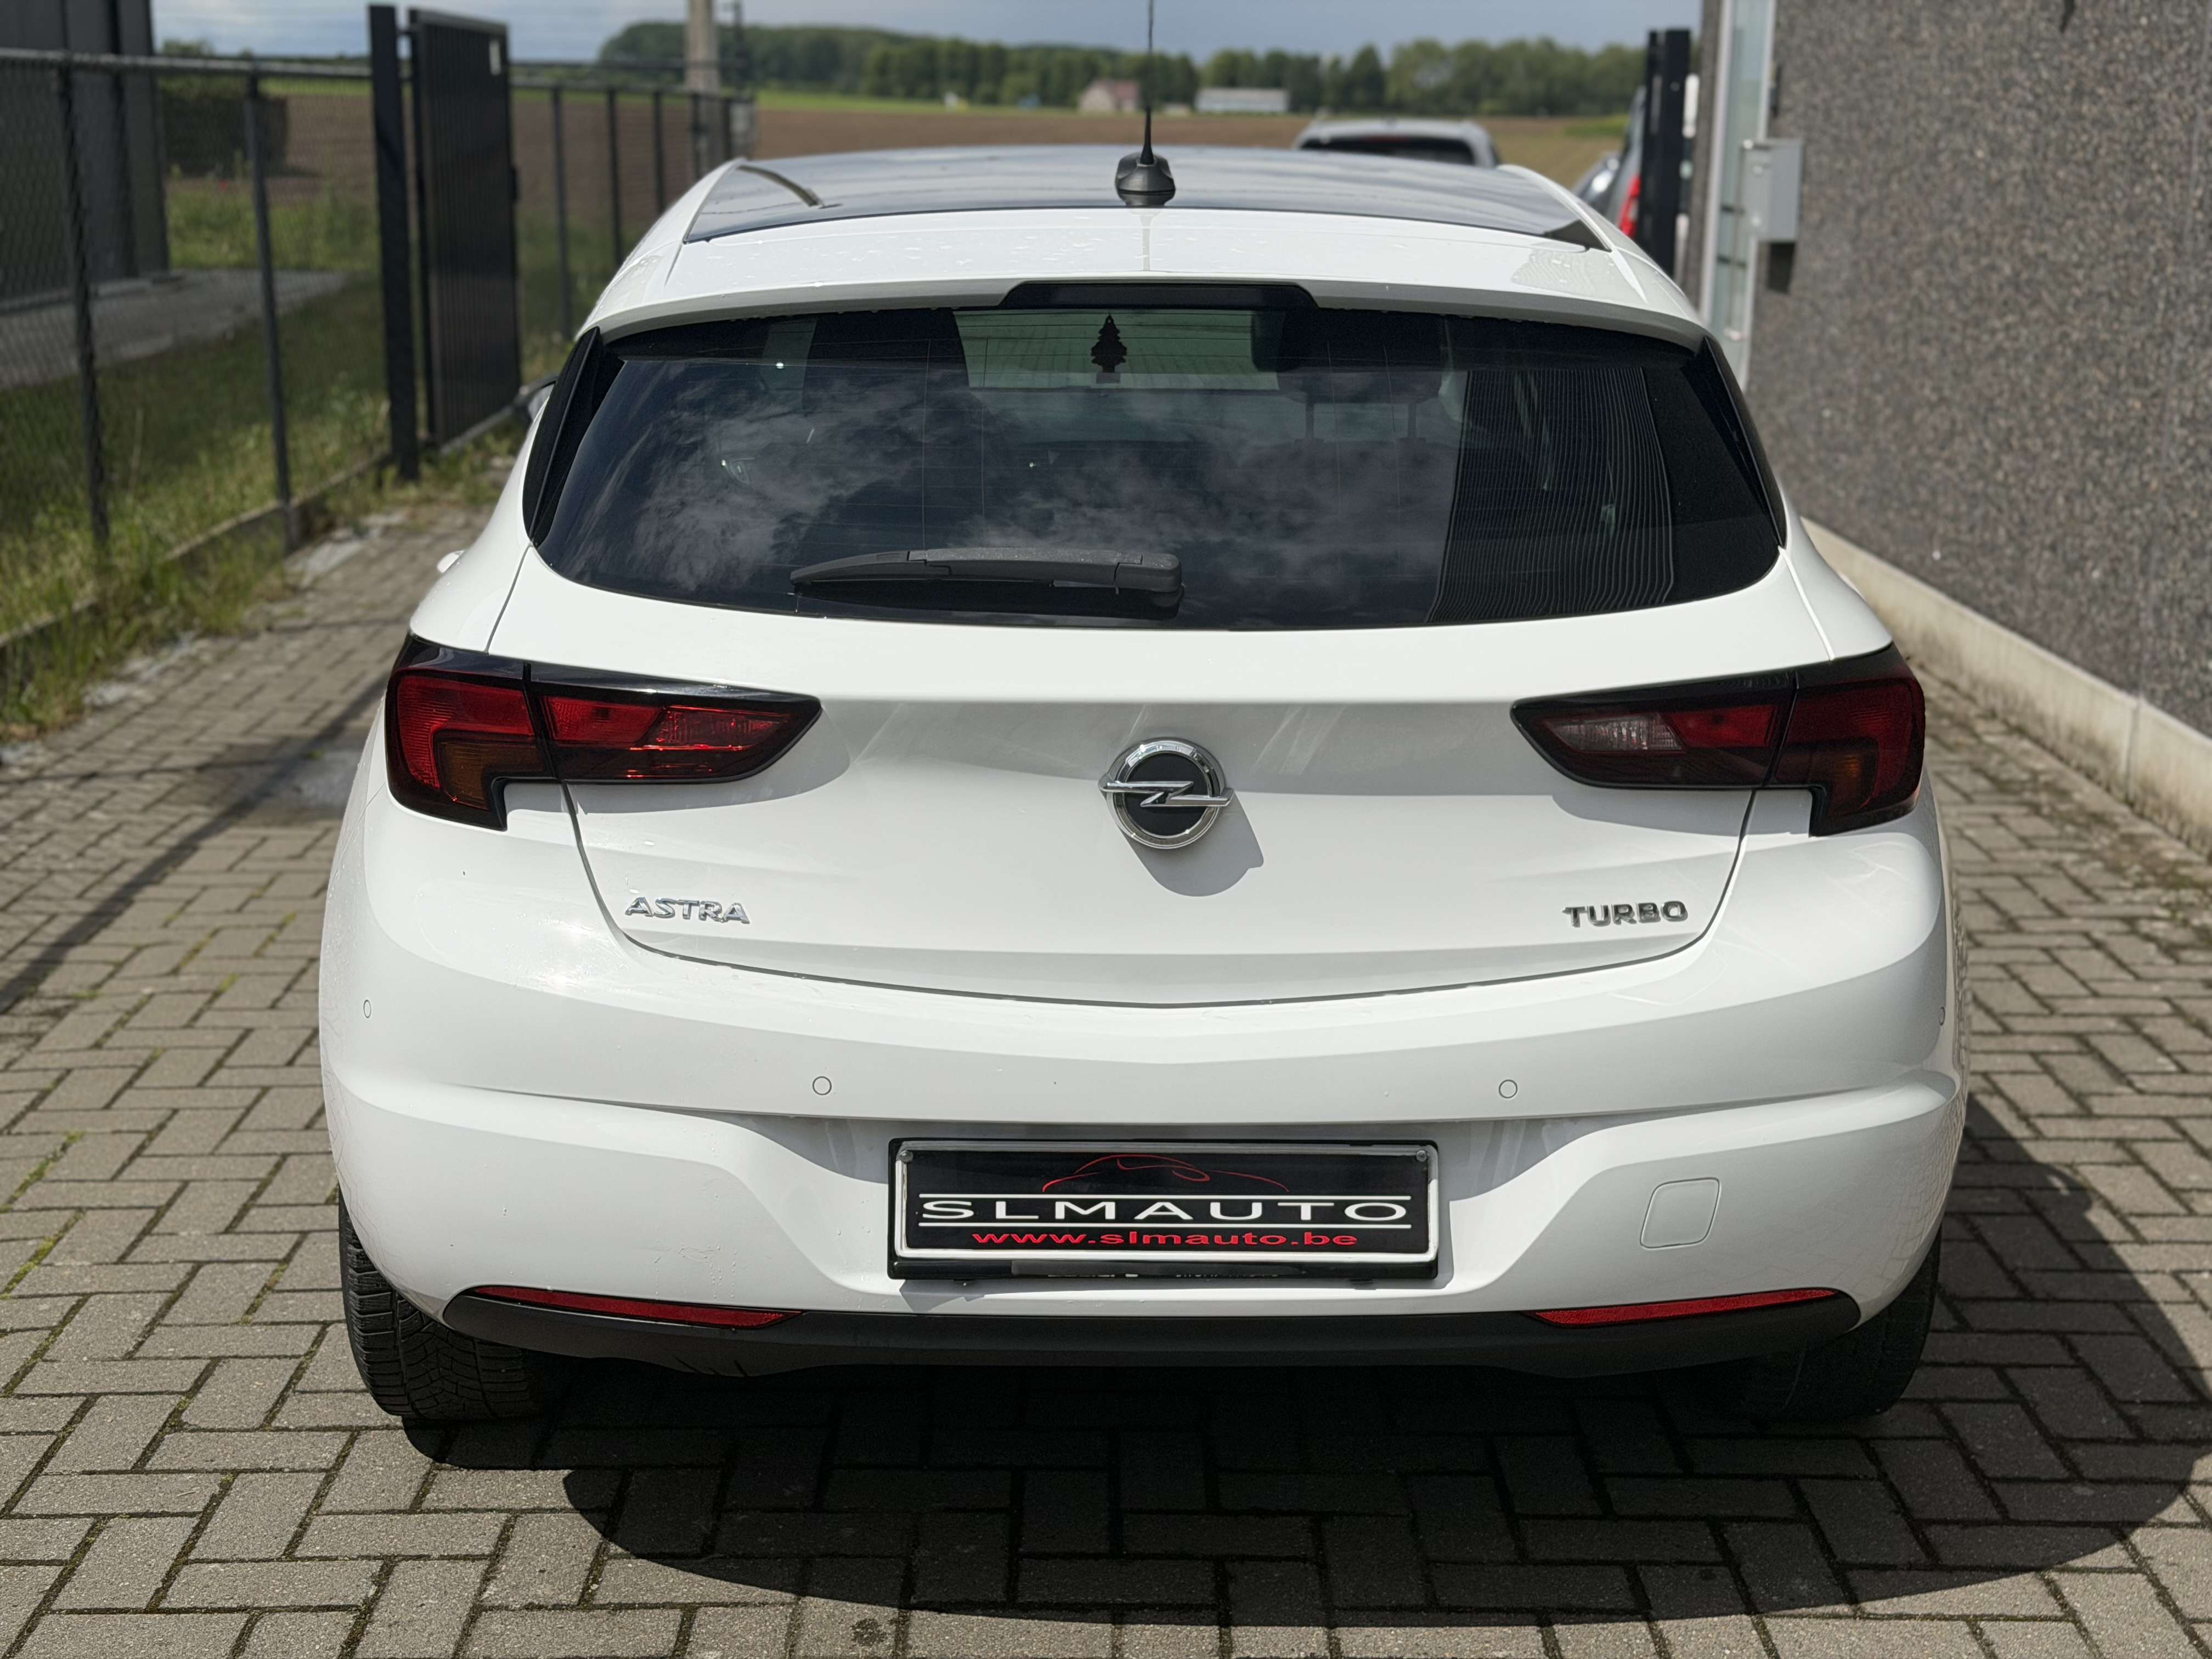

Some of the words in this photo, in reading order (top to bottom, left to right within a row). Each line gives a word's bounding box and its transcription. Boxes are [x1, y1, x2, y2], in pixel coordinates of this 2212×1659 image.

[625, 896, 751, 924] ASTRA
[1562, 901, 1688, 928] TURBO
[922, 1200, 1407, 1221] SLMAUTO
[972, 1231, 1357, 1246] www.slmauto.be
